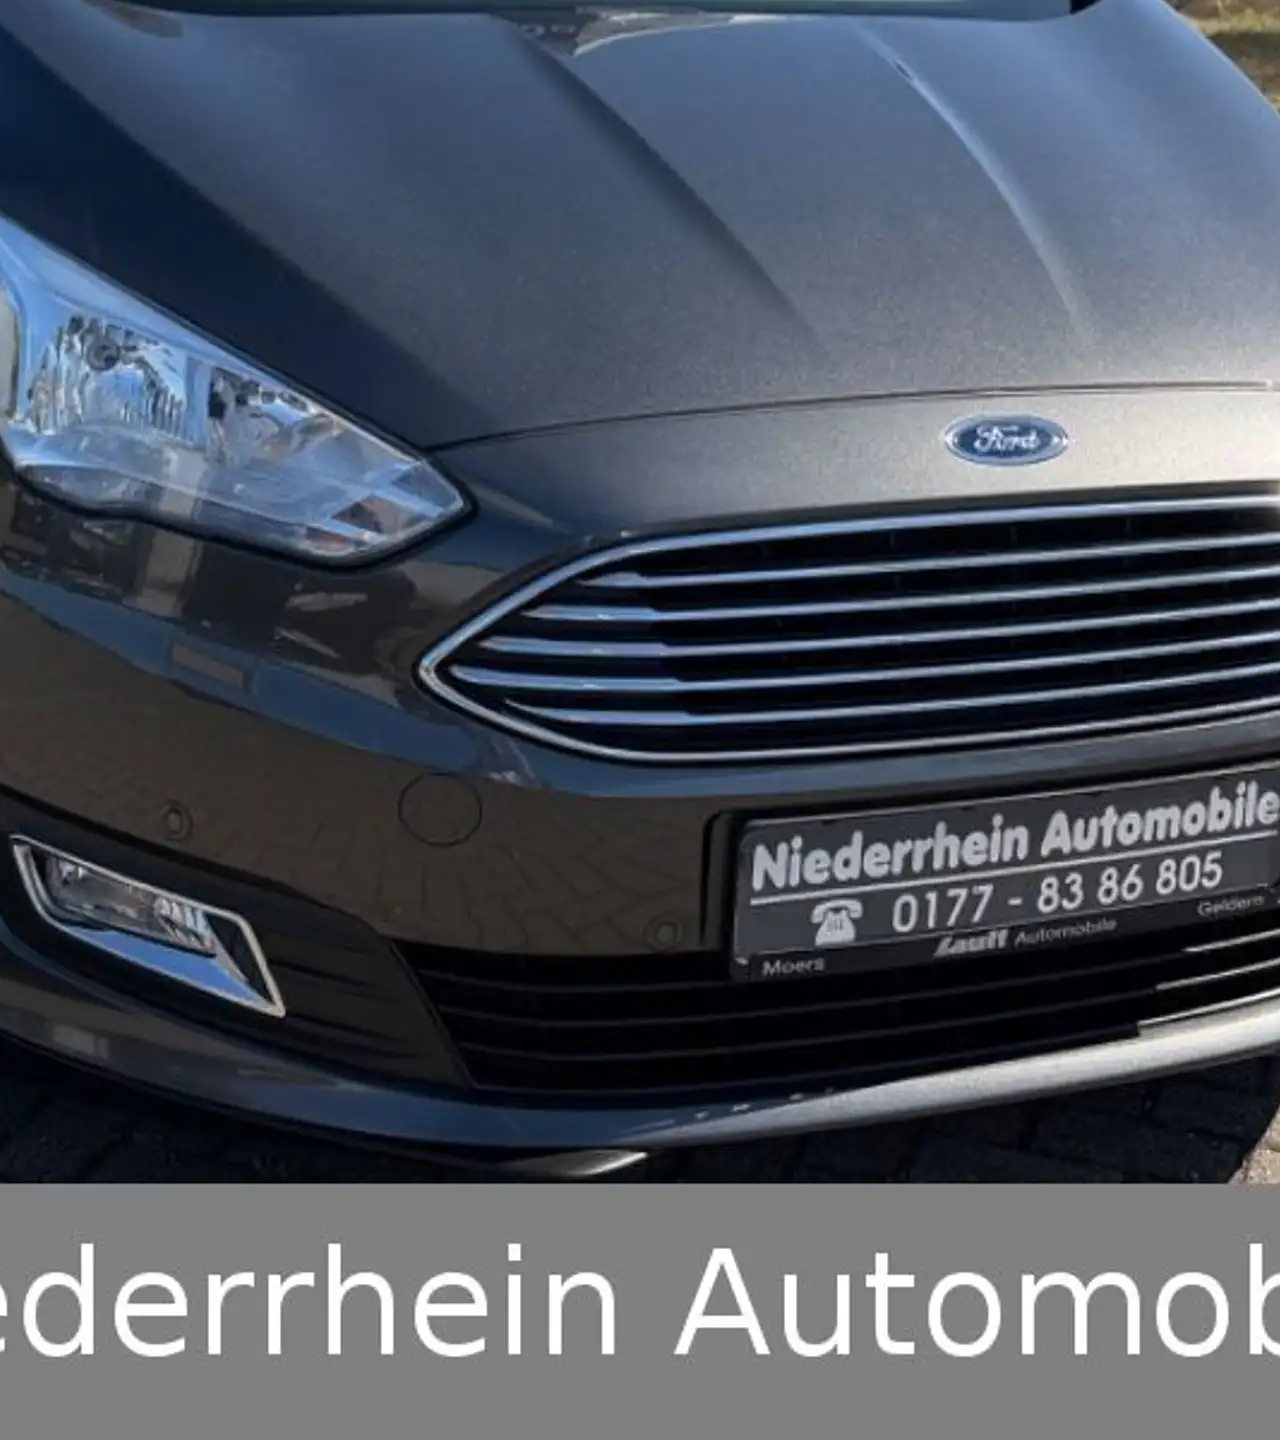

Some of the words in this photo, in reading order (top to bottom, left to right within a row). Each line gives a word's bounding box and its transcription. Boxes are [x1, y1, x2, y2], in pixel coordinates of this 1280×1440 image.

[973, 425, 1041, 453] Ford
[752, 813, 1029, 892] Niederrhein
[892, 883, 994, 933] 0177
[1037, 872, 1083, 914] 83
[1097, 863, 1144, 905] 86
[1155, 851, 1223, 895] 805
[1014, 917, 1118, 946] Automobile
